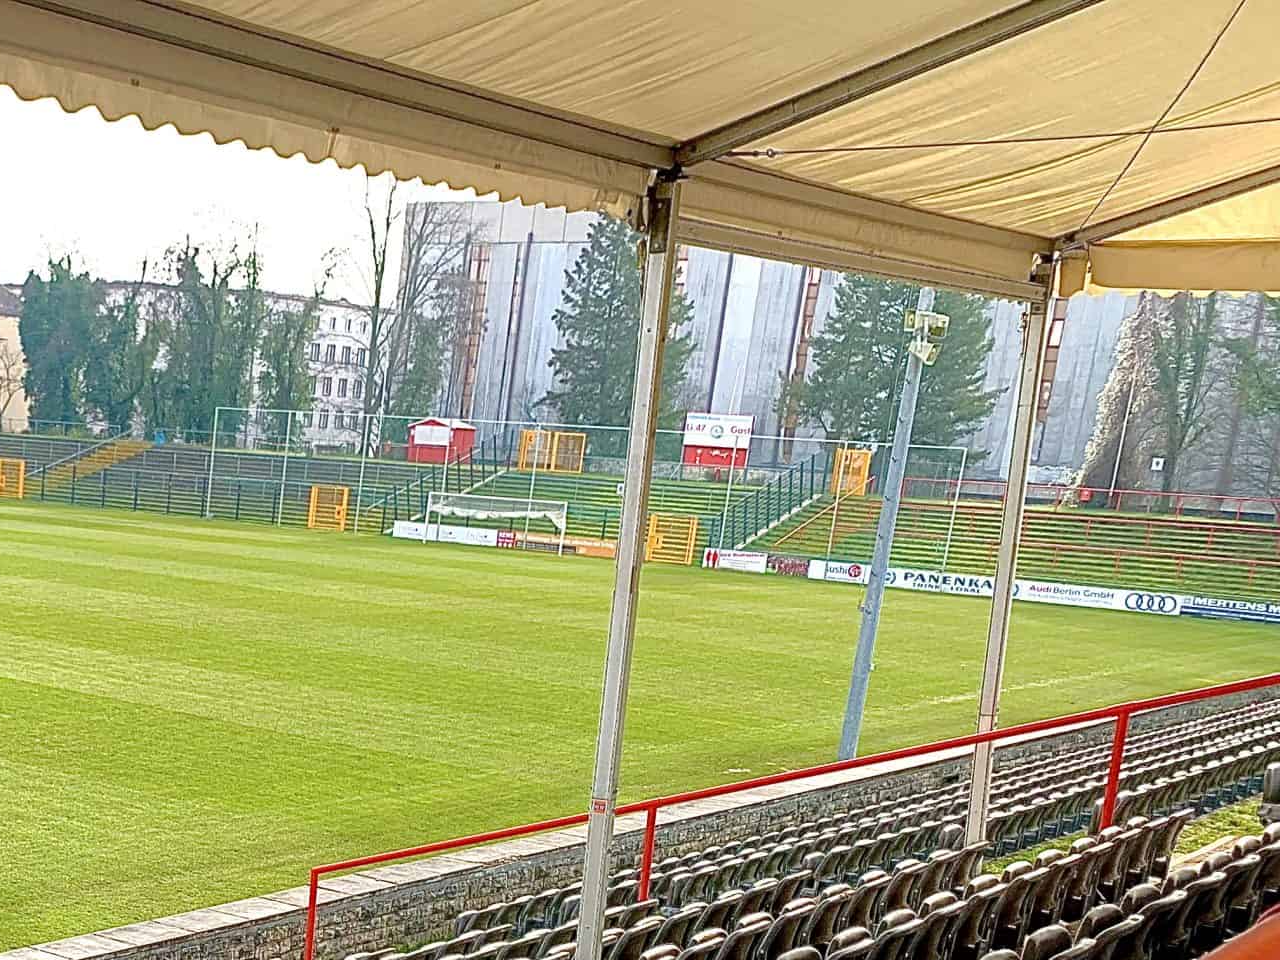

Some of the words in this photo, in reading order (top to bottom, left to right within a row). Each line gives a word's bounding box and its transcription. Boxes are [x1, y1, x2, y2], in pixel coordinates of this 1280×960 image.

[903, 571, 993, 589] PANENKA
[1029, 584, 1052, 593] Audi
[1053, 586, 1081, 596] Berlin
[1083, 589, 1115, 600] GmbH
[1193, 596, 1266, 612] MERTENS
